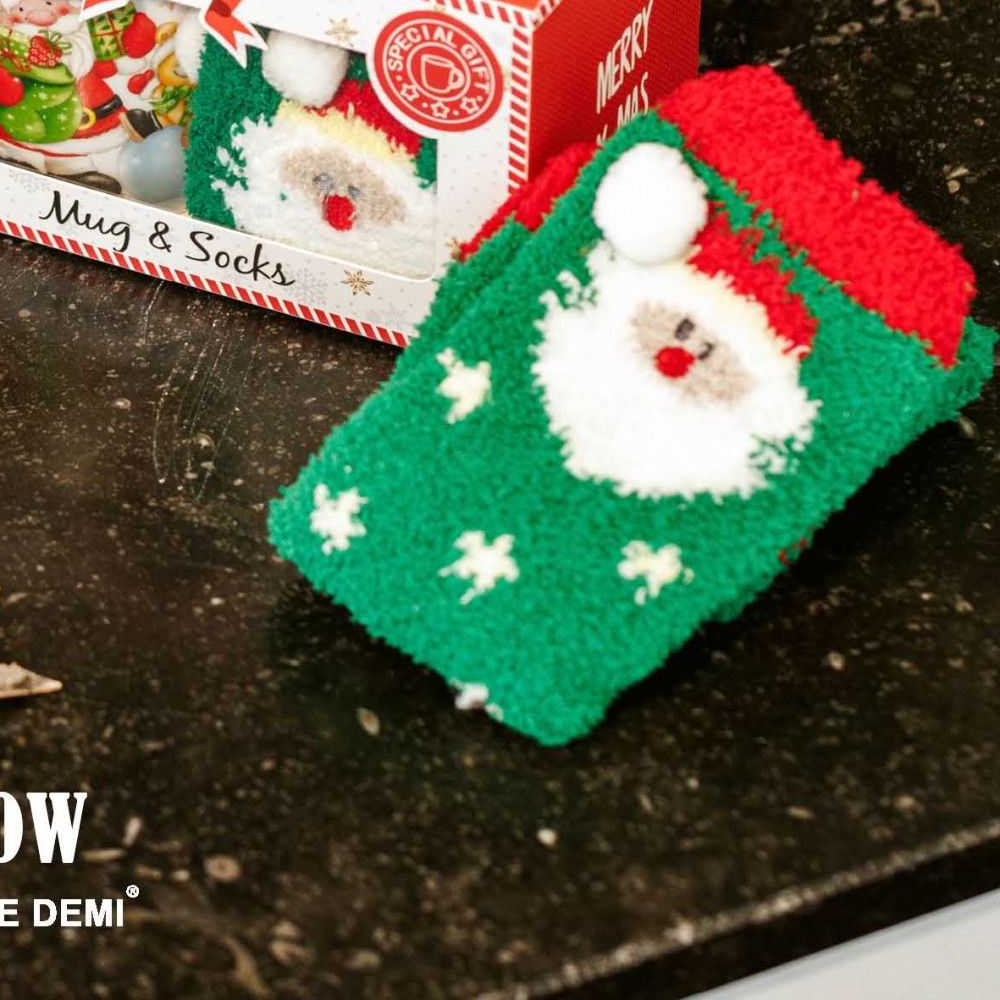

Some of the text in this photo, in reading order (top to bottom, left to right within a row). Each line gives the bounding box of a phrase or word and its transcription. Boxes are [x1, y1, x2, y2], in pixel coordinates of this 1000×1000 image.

[388, 24, 491, 95] SPECIAL GIFT
[38, 190, 296, 287] Mug & Socks
